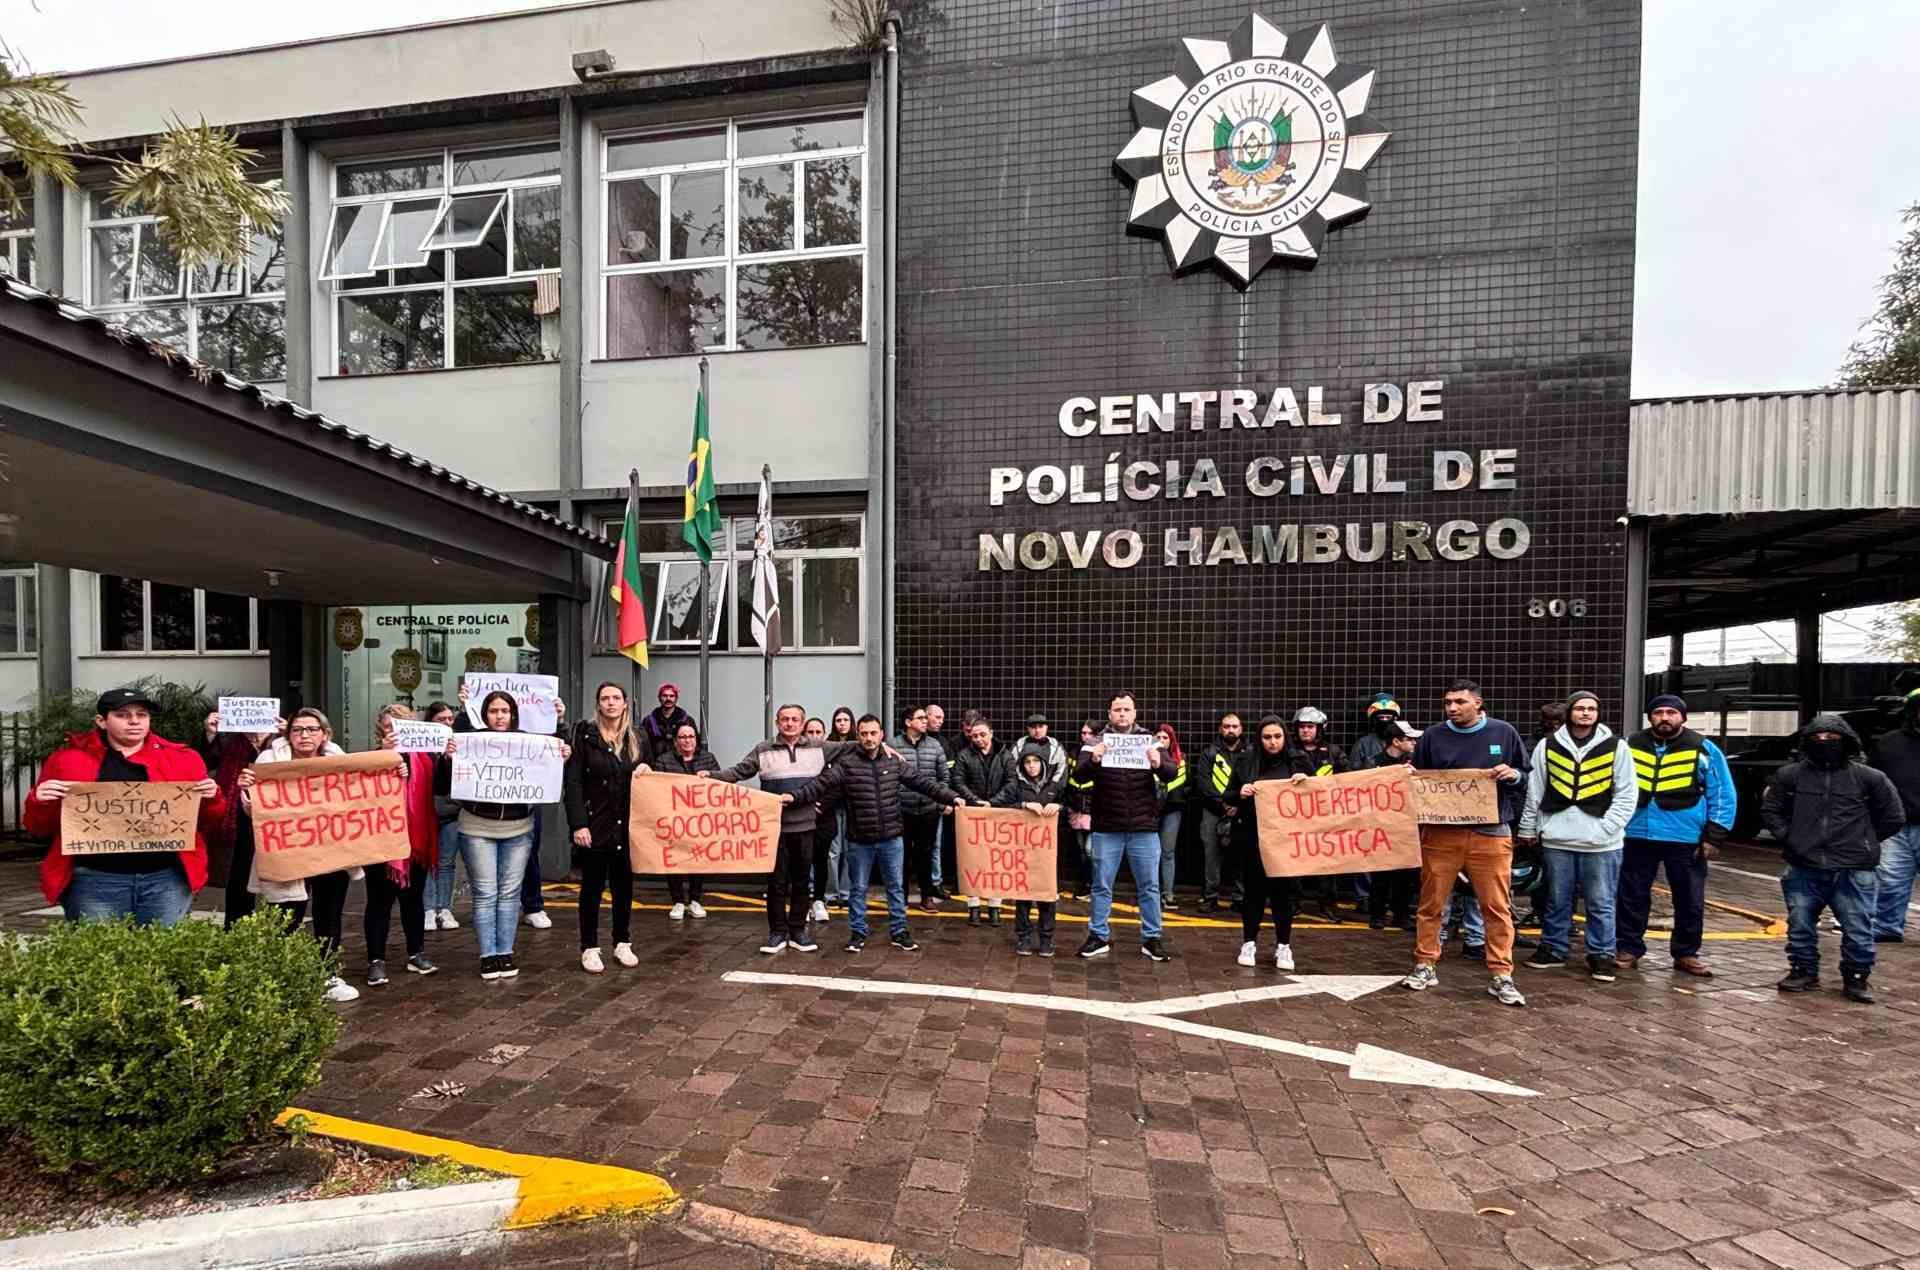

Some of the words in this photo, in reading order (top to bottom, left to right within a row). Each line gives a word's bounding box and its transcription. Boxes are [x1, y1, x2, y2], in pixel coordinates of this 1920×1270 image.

[1215, 65, 1246, 86] RIO
[1254, 62, 1324, 98] GRANDE
[1188, 83, 1210, 106] DO
[1320, 99, 1338, 124] DO
[1168, 109, 1189, 177] ESTADO
[1324, 130, 1341, 167] SUL
[1188, 202, 1263, 233] POLÍCIA
[1271, 193, 1319, 227] CIVIL
[1058, 384, 1342, 437] CENTRAL
[1363, 380, 1445, 425] DE
[988, 451, 1226, 506] POLÍCIA
[1245, 453, 1407, 498] CIVIL
[1432, 448, 1518, 492] DE
[977, 528, 1145, 571] NOVO
[1163, 517, 1532, 569] HAMBURGO
[376, 615, 434, 626] CENTRAL
[437, 615, 454, 625] DE
[458, 611, 510, 625] POLÍCIA
[1527, 598, 1588, 619] 806
[400, 736, 445, 748] CRIME
[256, 766, 402, 810] QUEREMOS
[474, 781, 545, 800] LEONARDO
[671, 783, 751, 811] NEGAR
[1277, 780, 1405, 820] QUEREMOS
[1416, 778, 1480, 796] JUSTIÇA
[75, 791, 170, 821] JUSTIÇA
[260, 804, 406, 852] RESPOSTAS
[655, 809, 761, 841] SOCORRO
[967, 815, 1053, 850] JUSTIÇA
[66, 839, 126, 851] #VITOR
[130, 839, 186, 850] LEONARDO
[690, 836, 769, 863] #CRIME
[1287, 827, 1393, 858] JUSTIÇA
[989, 848, 1029, 872] POR
[964, 870, 1030, 893] VITOR
